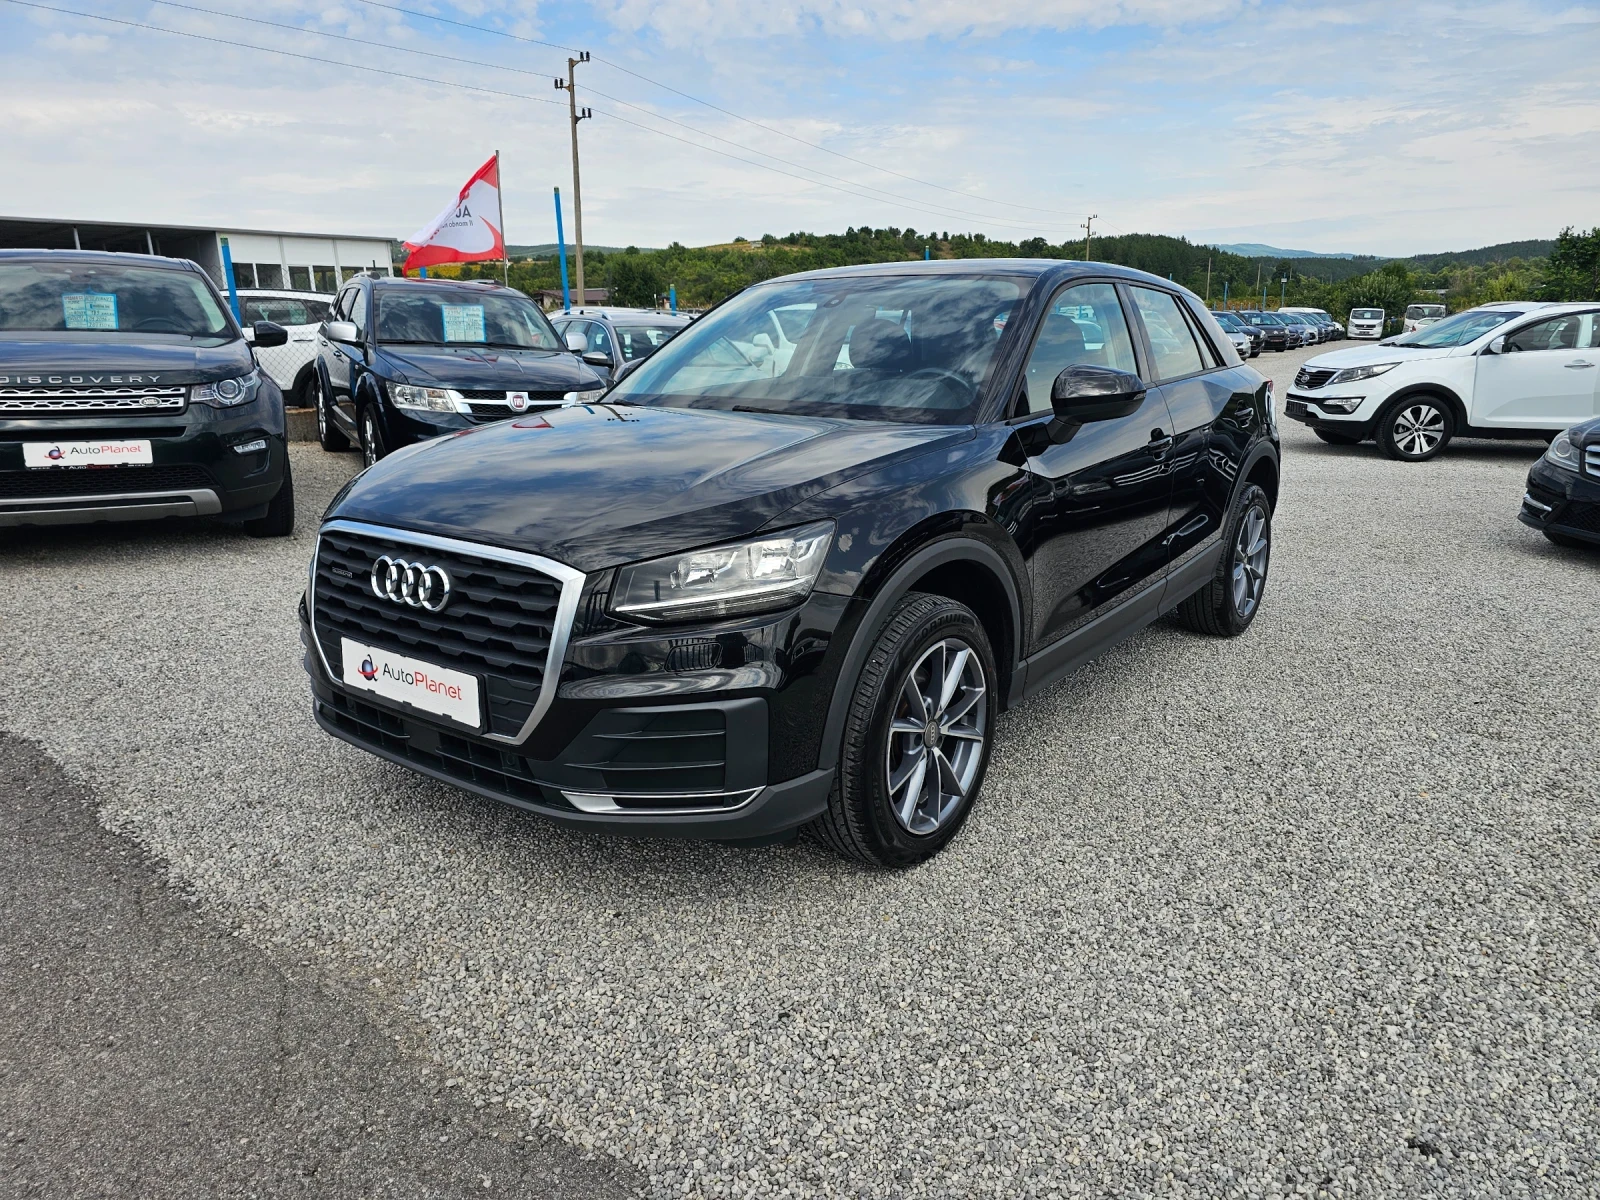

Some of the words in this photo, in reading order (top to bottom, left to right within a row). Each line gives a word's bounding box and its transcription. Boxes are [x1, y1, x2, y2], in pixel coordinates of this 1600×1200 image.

[0, 375, 161, 384] DISCOVERY
[70, 445, 142, 455] AutoPlanet
[382, 662, 463, 701] AutoPlanet
